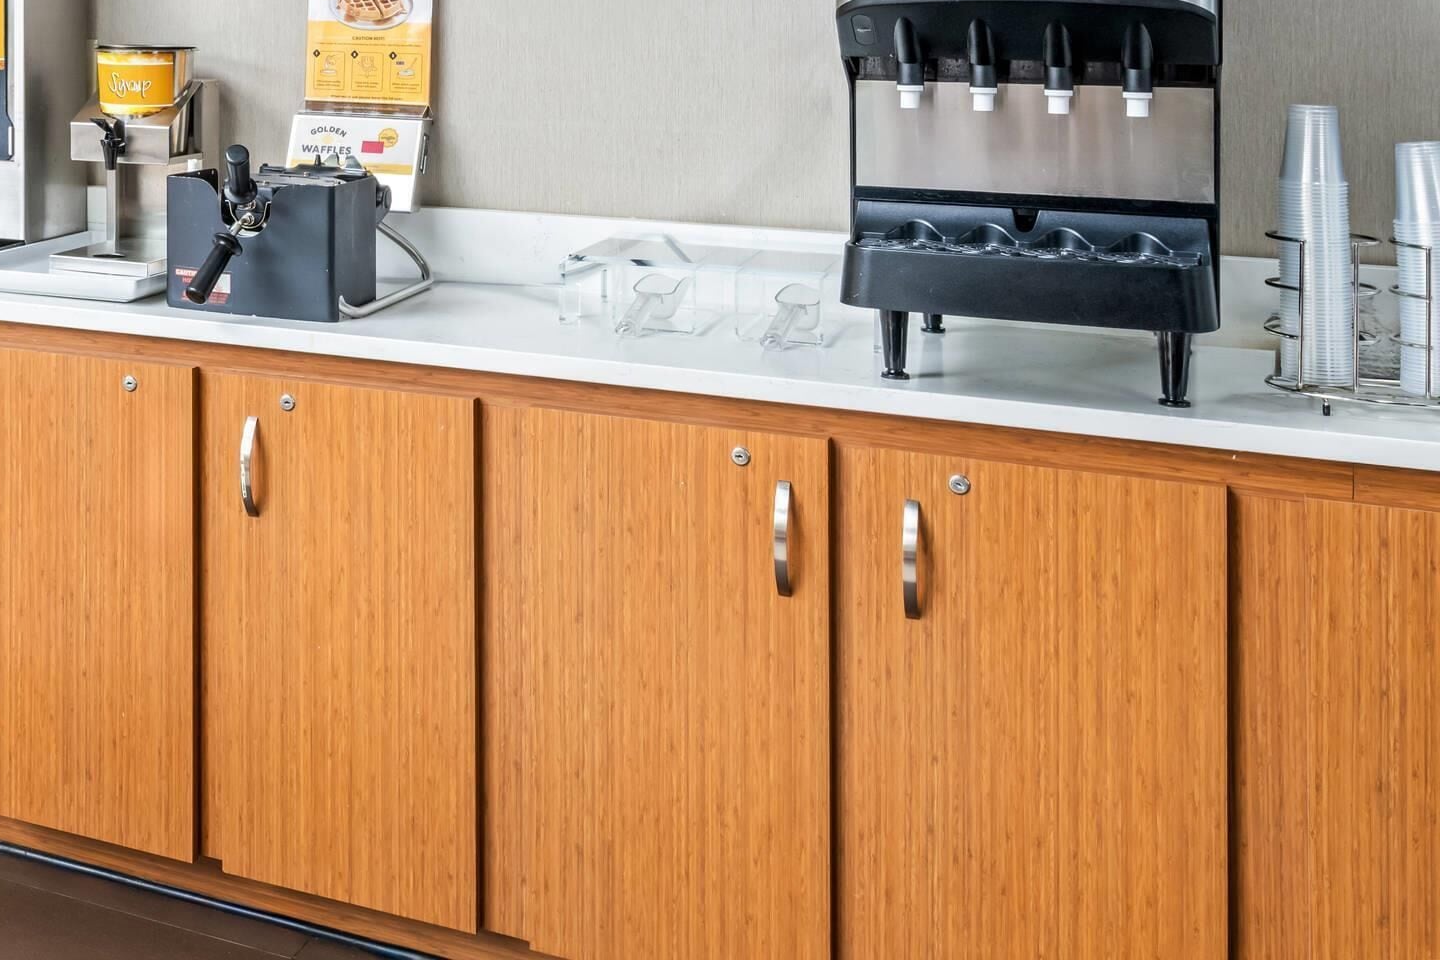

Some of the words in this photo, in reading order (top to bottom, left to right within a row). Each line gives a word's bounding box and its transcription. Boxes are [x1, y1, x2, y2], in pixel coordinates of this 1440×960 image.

[108, 71, 152, 99] Syrup
[310, 126, 347, 138] GOLDEN
[302, 144, 352, 155] WAFFLES
